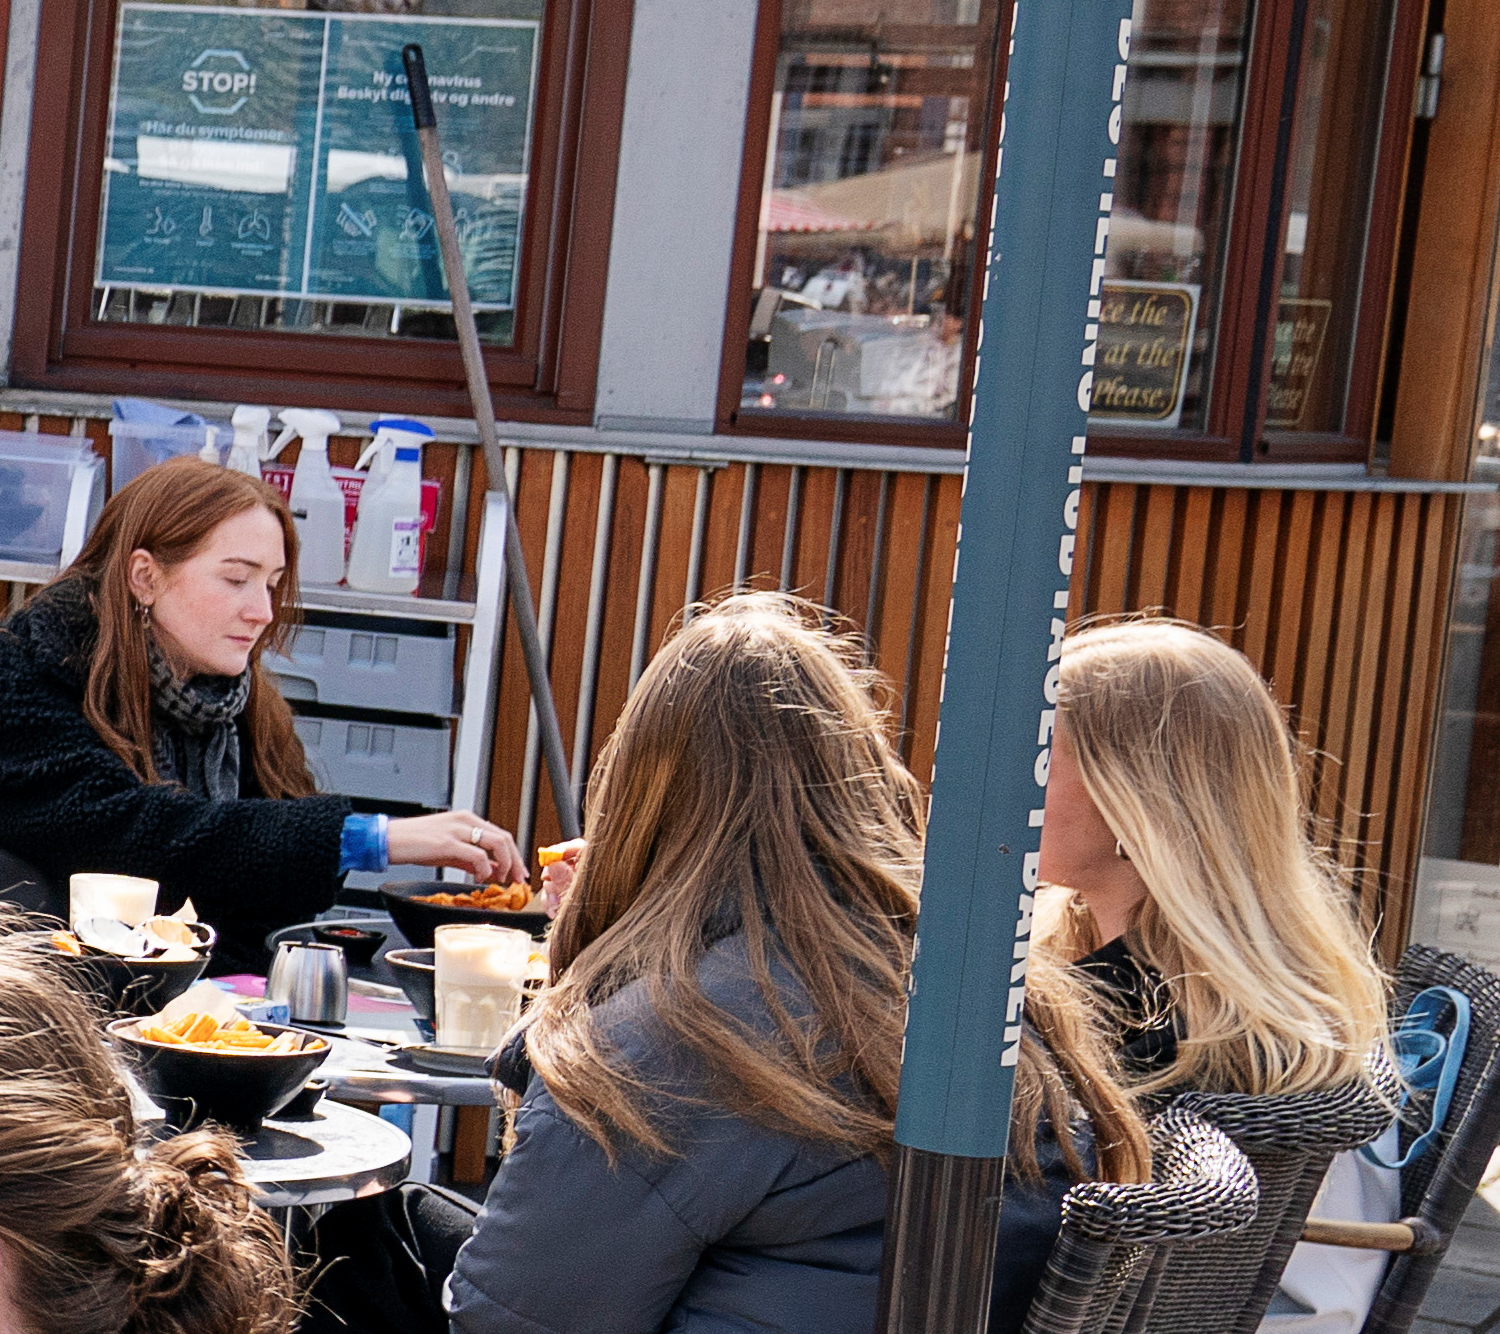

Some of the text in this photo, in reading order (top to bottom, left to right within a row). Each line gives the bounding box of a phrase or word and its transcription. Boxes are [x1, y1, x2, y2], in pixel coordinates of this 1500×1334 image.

[182, 69, 257, 95] STOP!
[1130, 294, 1169, 326] the
[1103, 335, 1177, 368] at the
